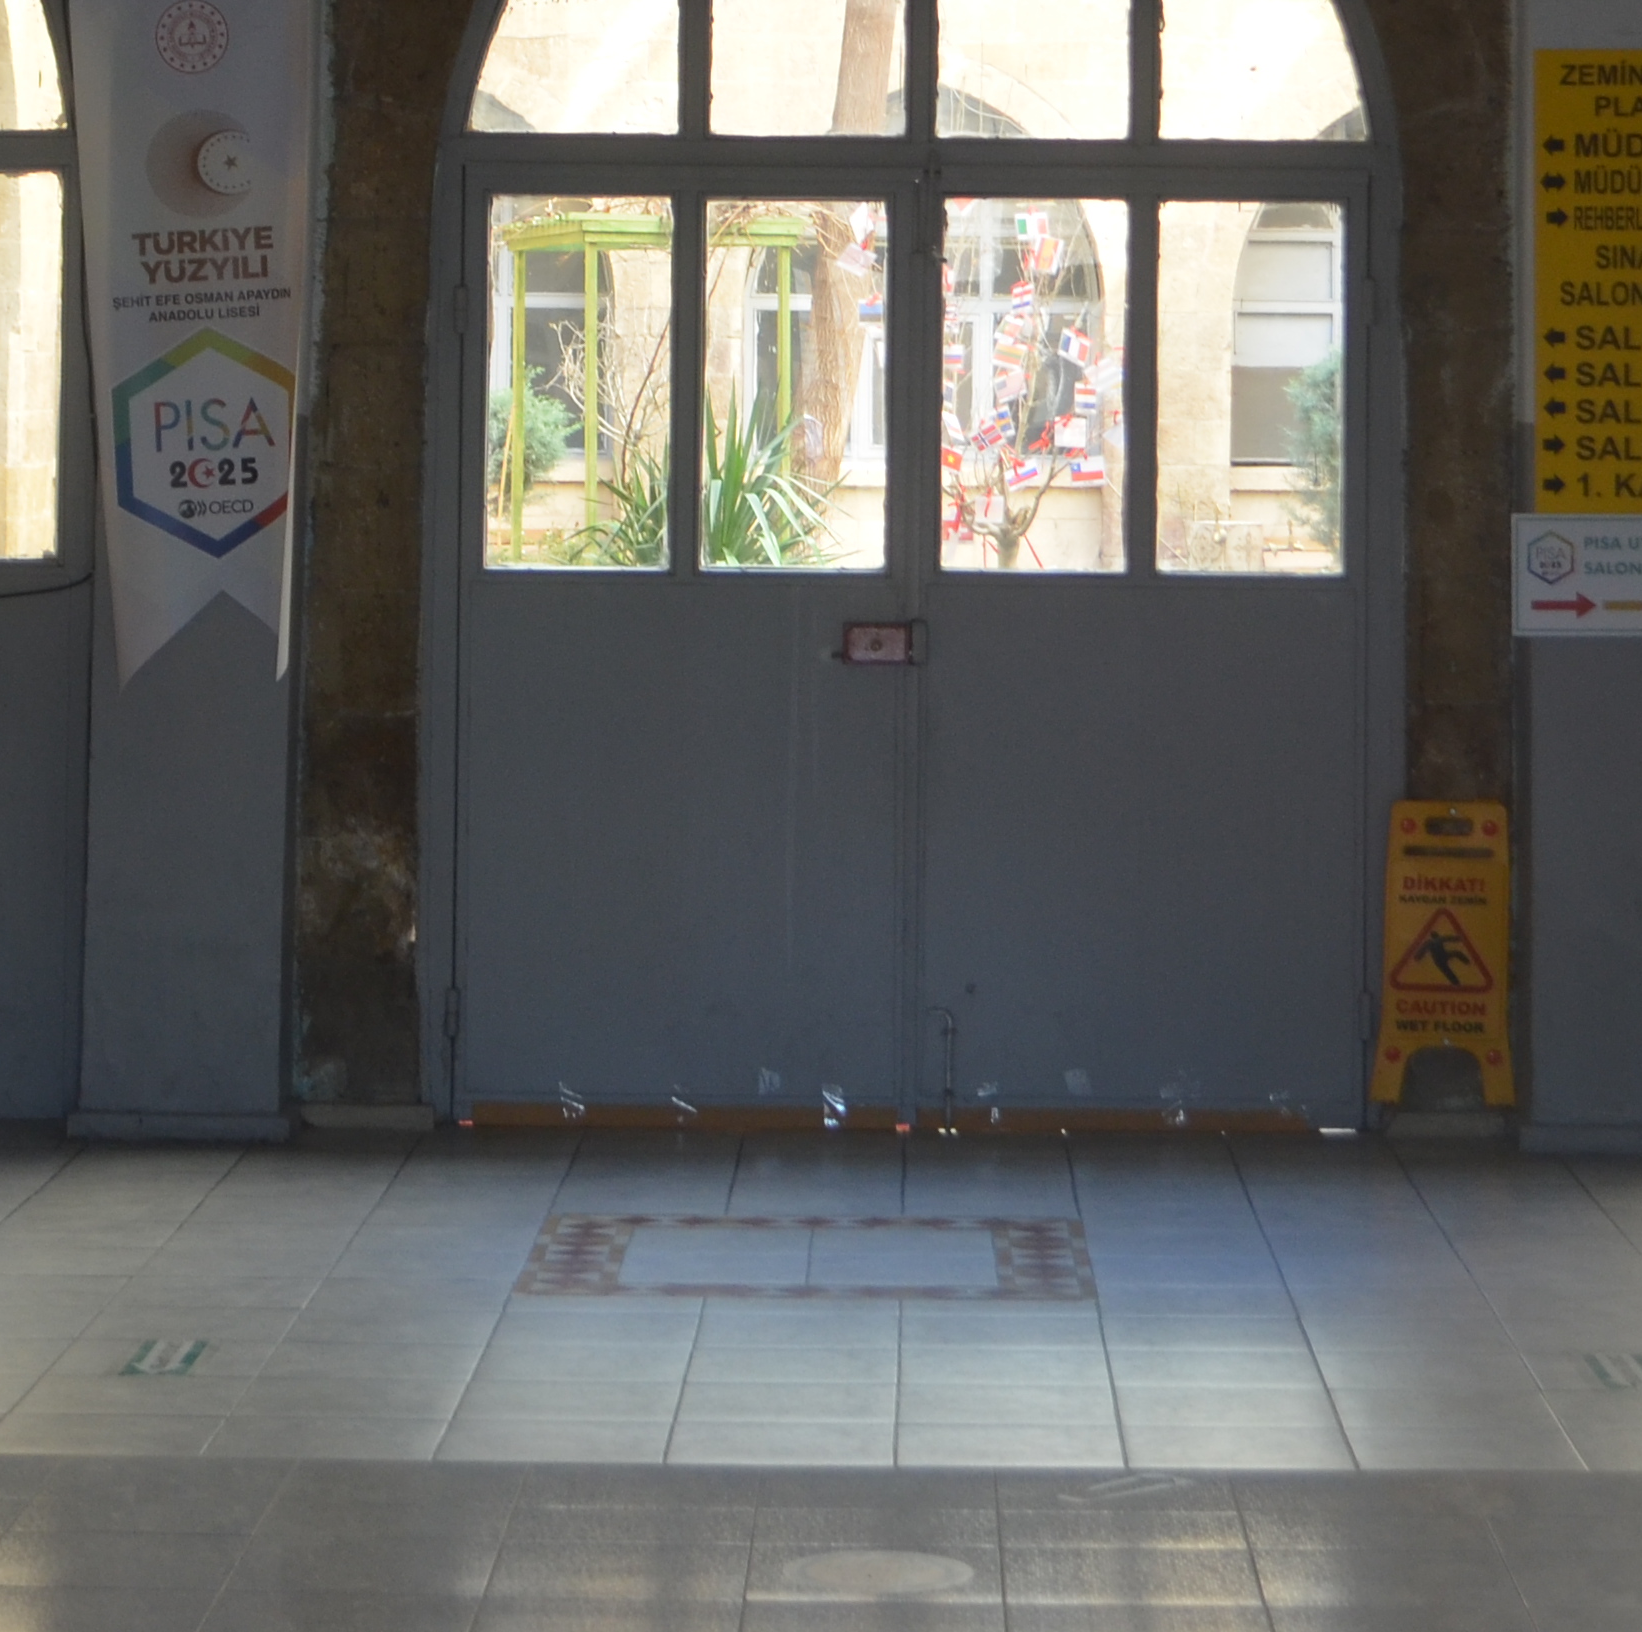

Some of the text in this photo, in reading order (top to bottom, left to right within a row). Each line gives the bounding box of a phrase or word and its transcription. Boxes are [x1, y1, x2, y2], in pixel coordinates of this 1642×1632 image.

[112, 287, 291, 311] ŞEHİT EFE OSMAN APAYDIN
[148, 309, 214, 323] ANADOLU
[153, 397, 276, 453] PISA
[1577, 472, 1602, 498] 1.
[208, 499, 254, 515] OECD
[1583, 536, 1622, 550] PISA
[1395, 998, 1487, 1017] CAUTION
[1395, 1019, 1486, 1035] WET FLOOR
